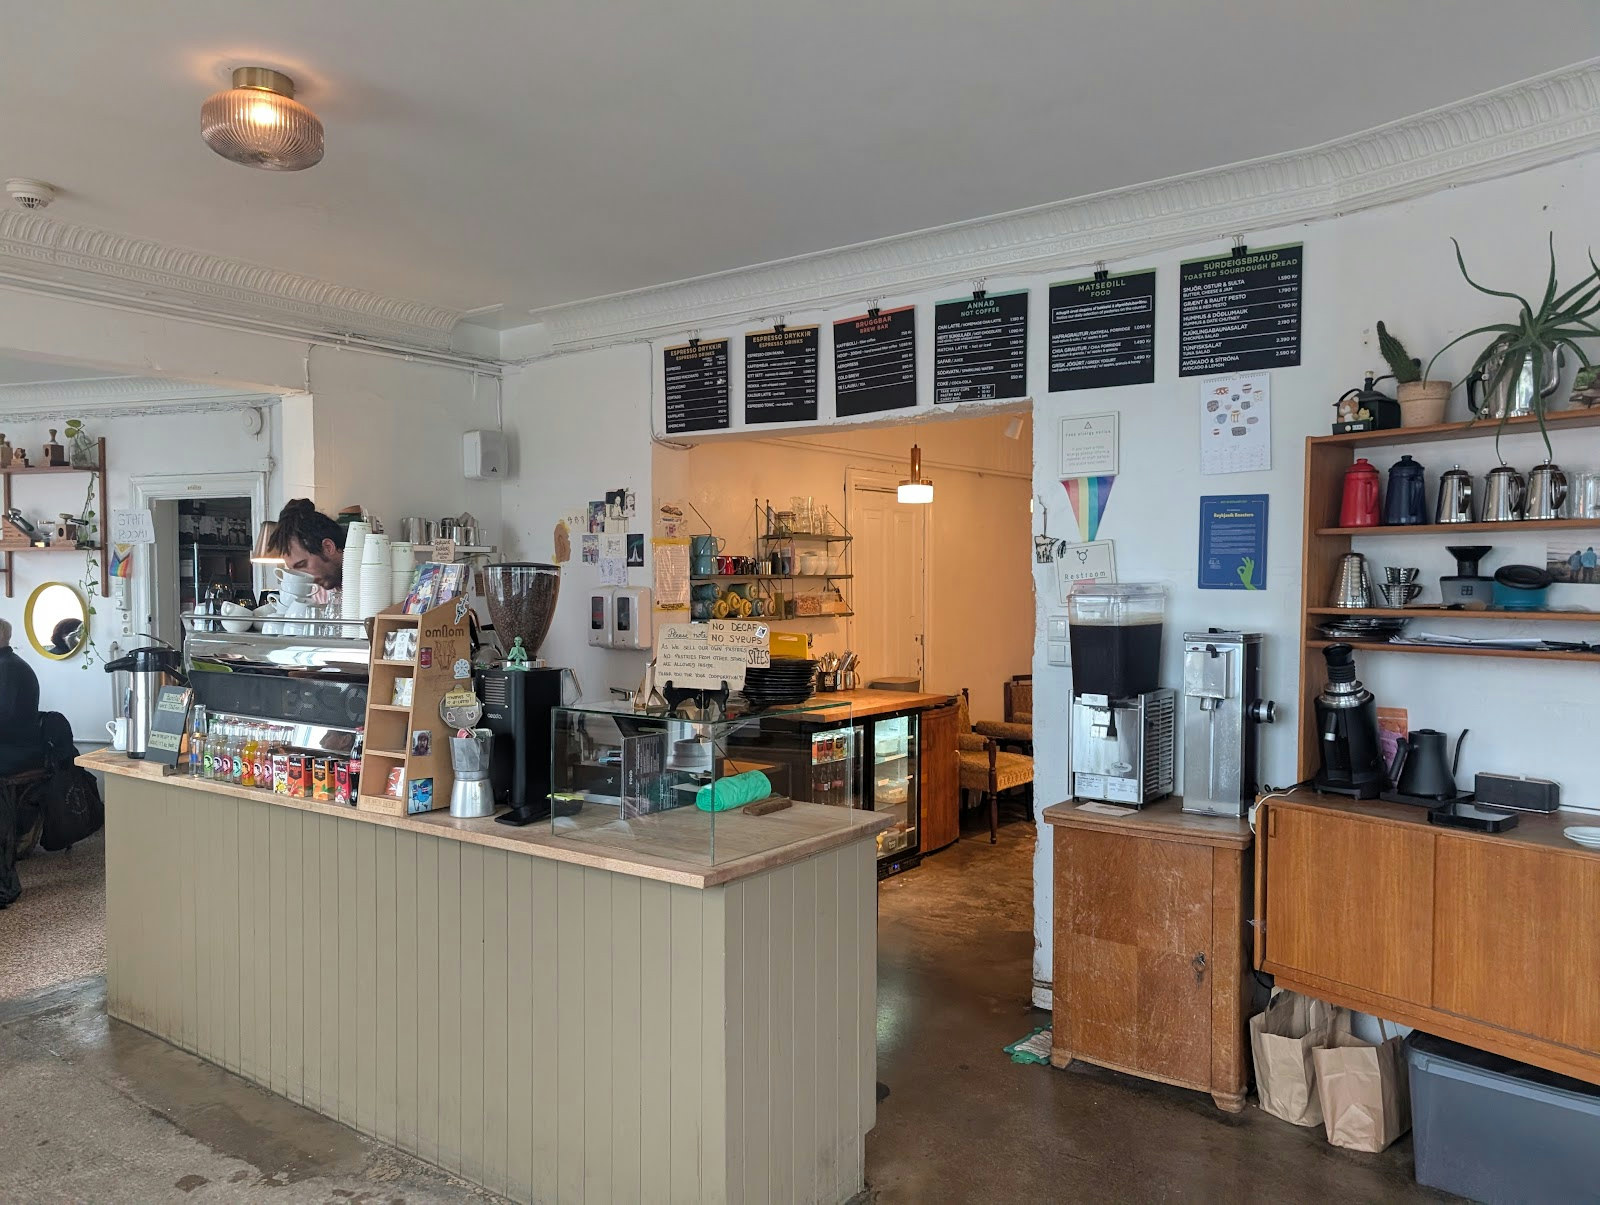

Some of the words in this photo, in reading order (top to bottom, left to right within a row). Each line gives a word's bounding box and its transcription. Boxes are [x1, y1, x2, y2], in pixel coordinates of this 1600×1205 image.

[1203, 251, 1278, 270] SÚRDEIGSBRAUÐ
[1183, 270, 1216, 281] TOASTED
[1219, 263, 1267, 275] SOURDOUGH
[1270, 258, 1297, 268] BREAD
[1203, 281, 1222, 290] OSTUR
[1090, 289, 1110, 297] FOOD
[975, 306, 999, 315] COFFEE
[855, 315, 891, 328] BRUGGBAR
[1183, 313, 1206, 321] HUMMUS
[859, 325, 875, 333] BREW
[876, 322, 888, 330] BAR
[752, 333, 782, 342] ESPRESSO
[784, 330, 811, 339] DRYKKIR
[670, 346, 697, 356] ESPRESSO
[697, 343, 721, 352] DRYKKIR
[1064, 571, 1106, 580] Restroom
[712, 622, 724, 631] NO
[732, 622, 758, 632] DECAF
[668, 628, 688, 638] Please
[711, 634, 724, 642] NO
[730, 635, 762, 644] SYRUPS
[748, 649, 770, 664] SIZES
